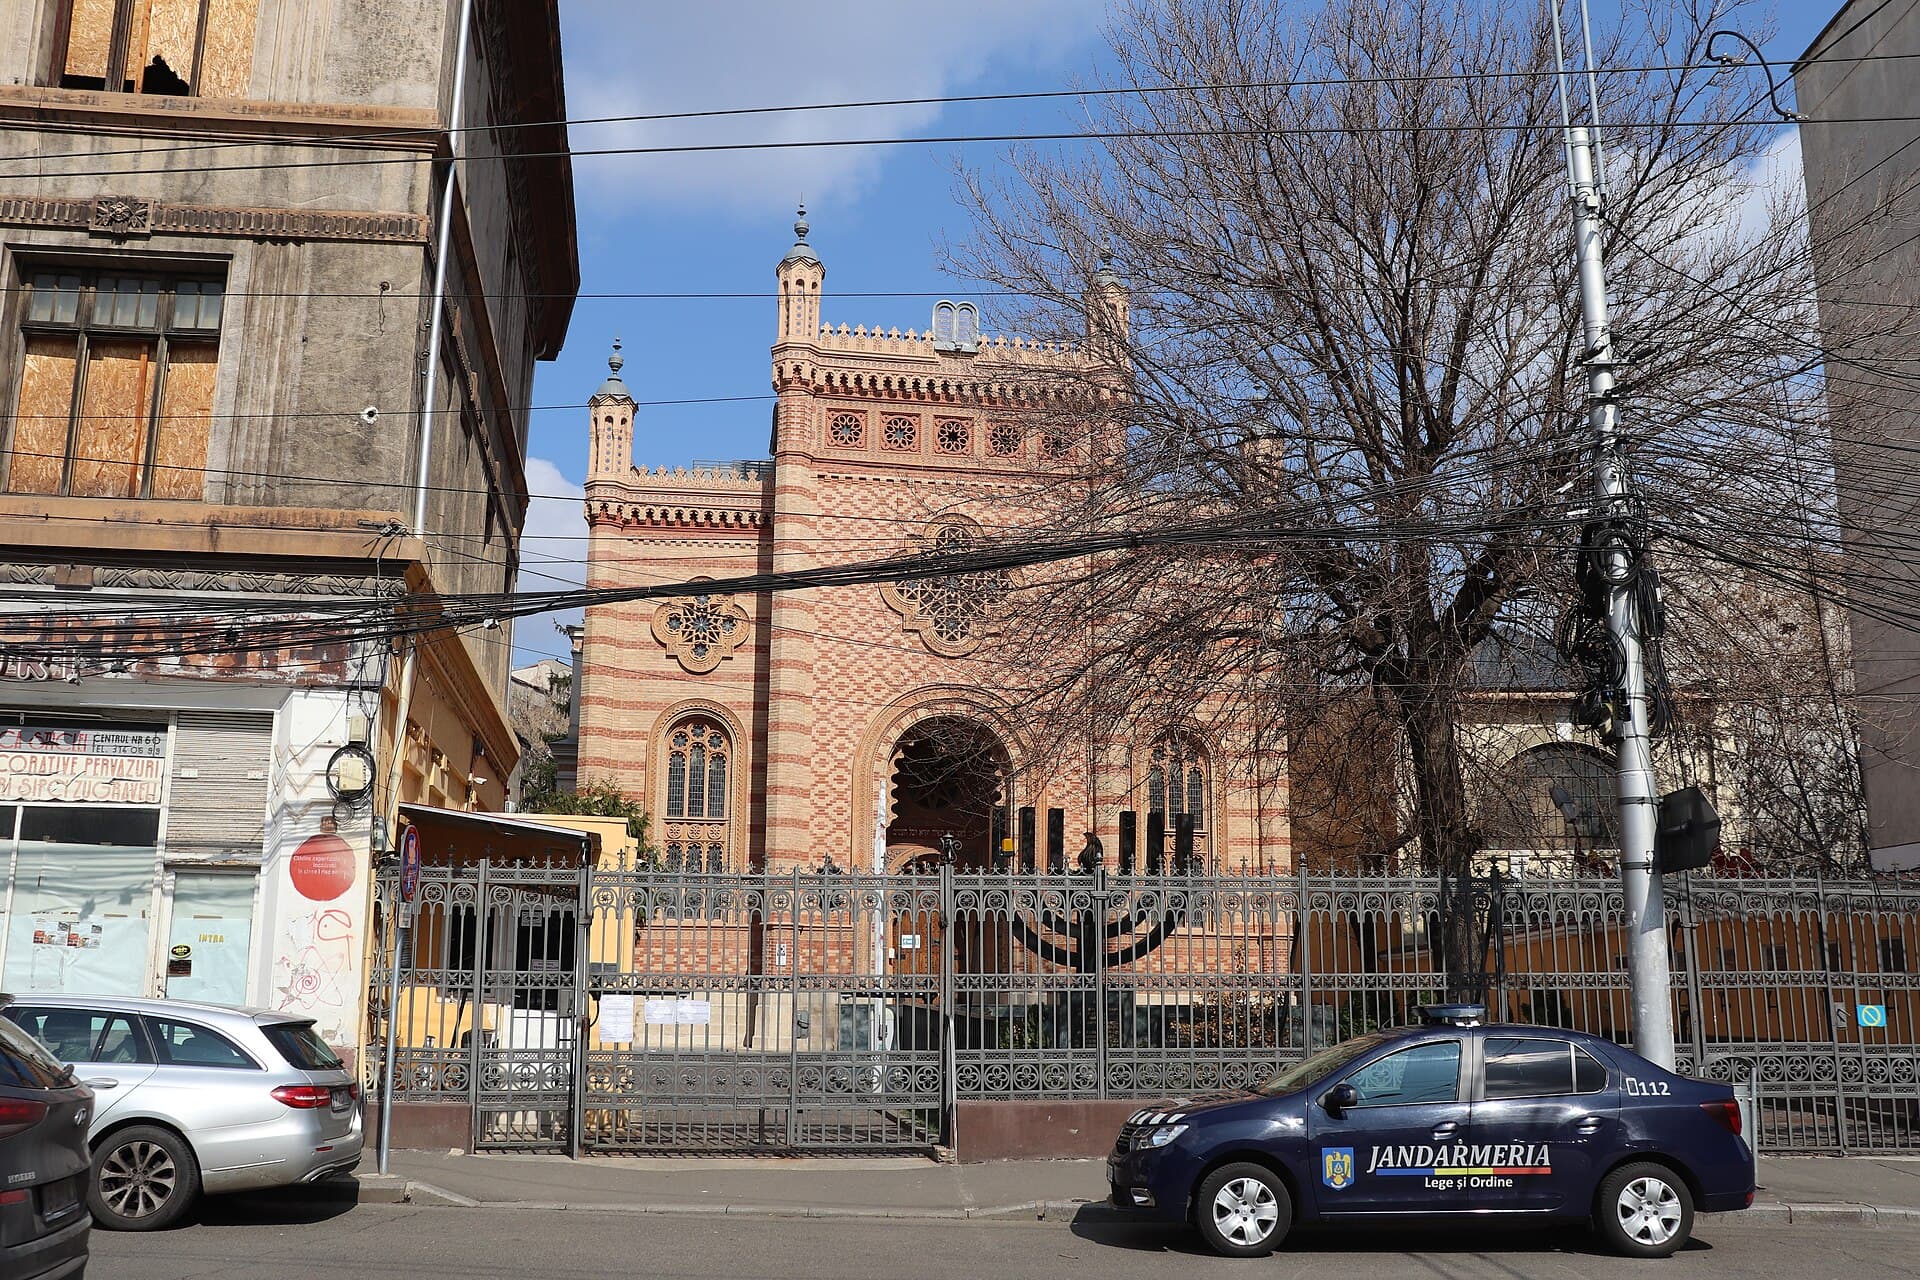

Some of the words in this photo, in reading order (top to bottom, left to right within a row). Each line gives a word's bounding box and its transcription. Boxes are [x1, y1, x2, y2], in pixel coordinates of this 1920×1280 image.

[94, 734, 129, 744] CENTRUL
[131, 735, 143, 744] NR
[85, 757, 160, 778] PERVAZURI
[1638, 1081, 1671, 1096] 112
[1366, 1144, 1551, 1173] JANDARMERIA
[1425, 1176, 1454, 1190] Lege
[1456, 1176, 1467, 1190] și
[1470, 1176, 1513, 1188] Ordine
